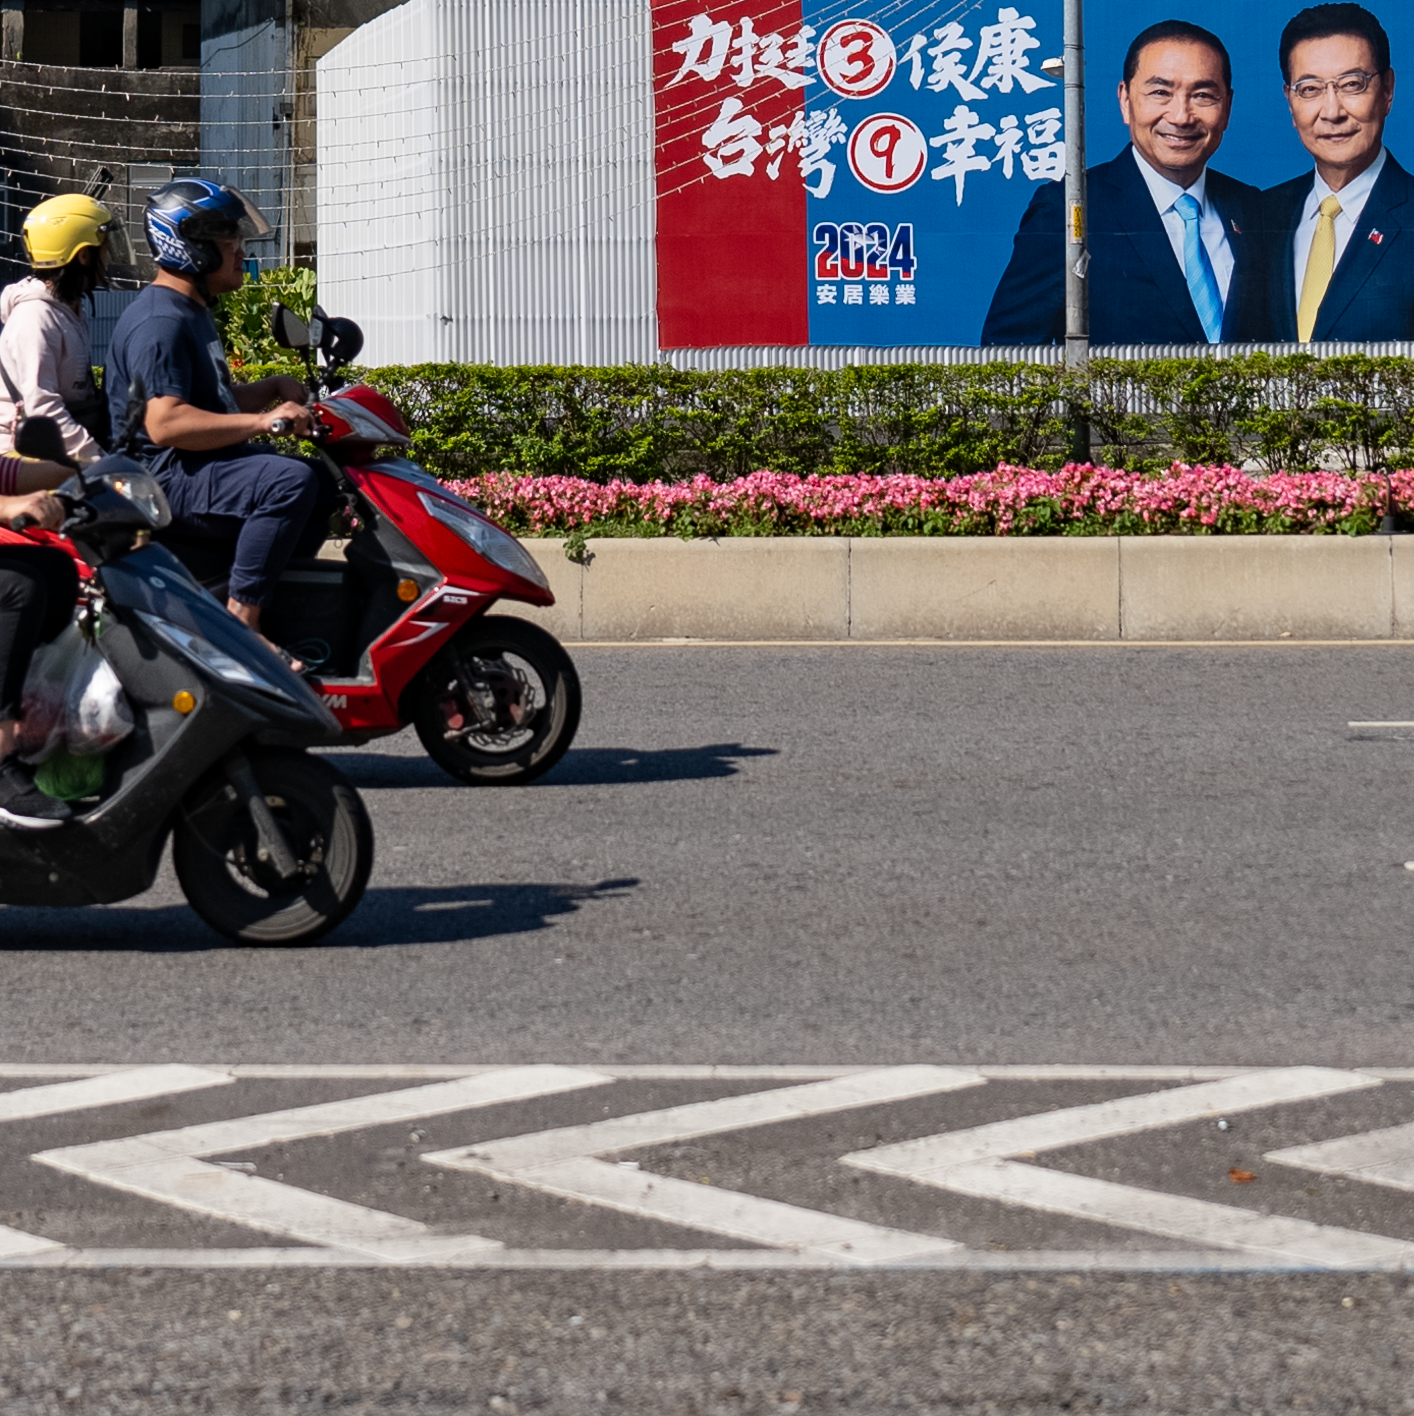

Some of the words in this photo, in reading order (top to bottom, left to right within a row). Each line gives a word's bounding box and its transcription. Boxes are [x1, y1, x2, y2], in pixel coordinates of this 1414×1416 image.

[813, 222, 917, 281] 2024
[816, 283, 917, 305] 安居樂業
